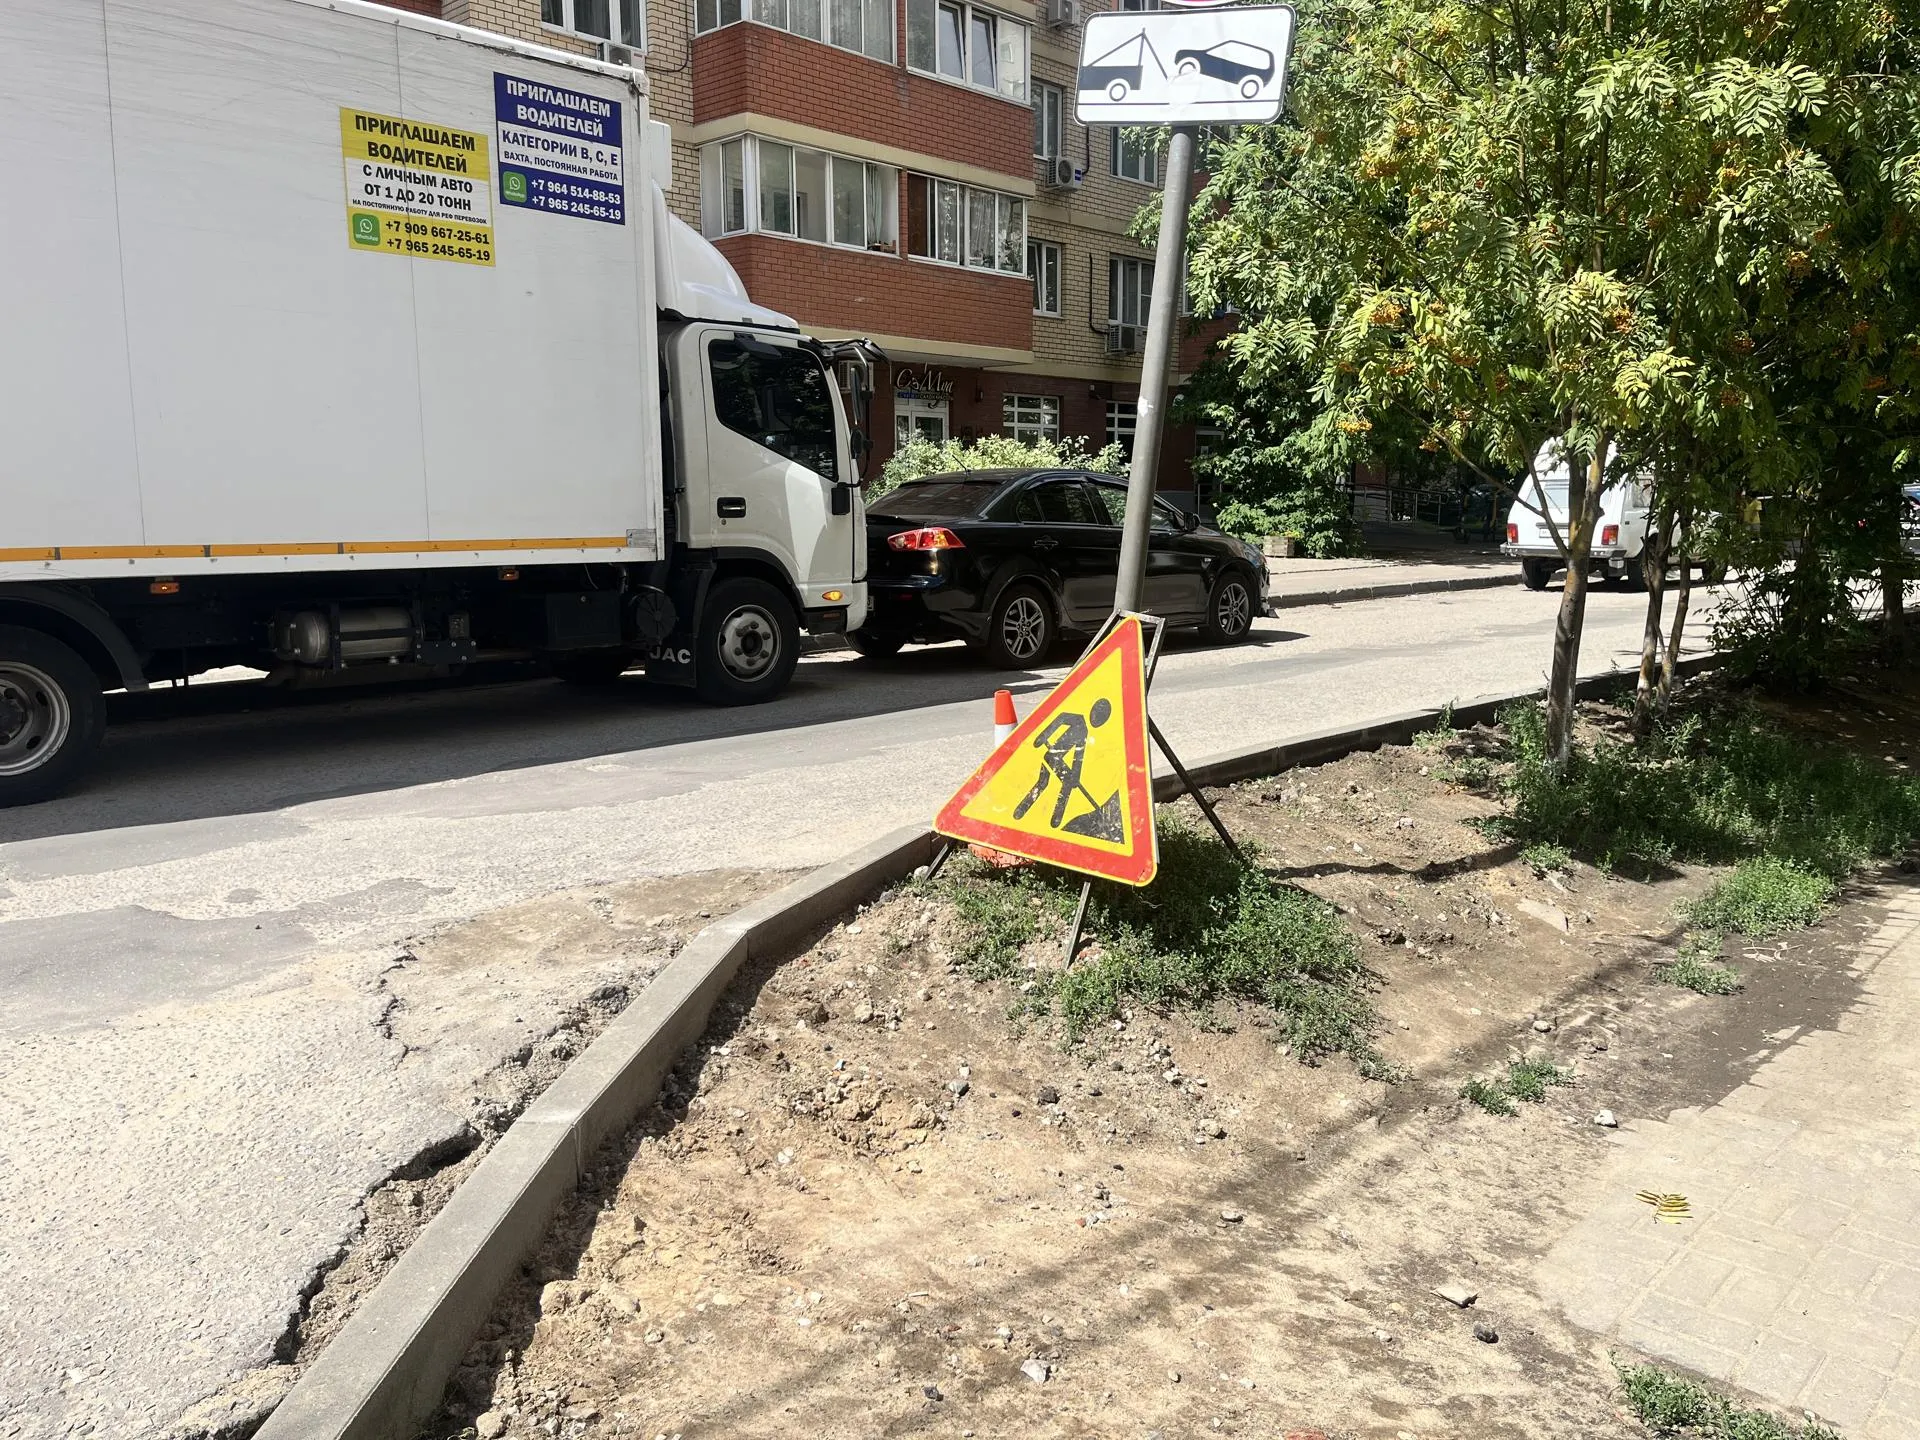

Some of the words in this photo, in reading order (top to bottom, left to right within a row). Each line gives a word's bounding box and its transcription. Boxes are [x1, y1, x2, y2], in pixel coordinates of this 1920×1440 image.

[506, 79, 611, 117] ПРИГЛАШАЕМ
[355, 114, 476, 152] ПРИГЛАШАЕМ
[516, 104, 603, 138] ВОДИТЕЛЕЙ
[367, 141, 467, 173] ВОДИТЕЛЕЙ
[502, 130, 577, 158] КАТЕГОРИИ
[610, 153, 618, 166] Е
[363, 164, 372, 177] С
[376, 166, 437, 188] ЛИЧНЫМ
[440, 177, 473, 193] АВТО
[504, 150, 533, 165] ВАХТА,
[534, 157, 588, 175] ПОСТОЯННАЯ
[589, 168, 618, 181] РАБОТА
[364, 183, 381, 195] ОТ
[385, 186, 393, 199] 1
[396, 188, 415, 203] ДО
[418, 191, 435, 205] 20
[437, 195, 471, 211] ТОНН
[531, 179, 545, 190] +7
[547, 181, 568, 194] 964
[570, 185, 621, 205] 514-88-53
[362, 200, 405, 212] ПОСТОЯННУЮ
[405, 206, 428, 216] РАБОТУ
[532, 196, 545, 206] +7
[548, 198, 569, 211] 965
[571, 202, 621, 220] 245-65-19
[385, 221, 401, 232] +7
[404, 222, 428, 236] 909
[431, 226, 490, 245] 667-25-61
[387, 238, 402, 250] +7
[405, 240, 429, 253] 965
[432, 243, 490, 261] 245-65-19
[649, 646, 691, 664] JAC
